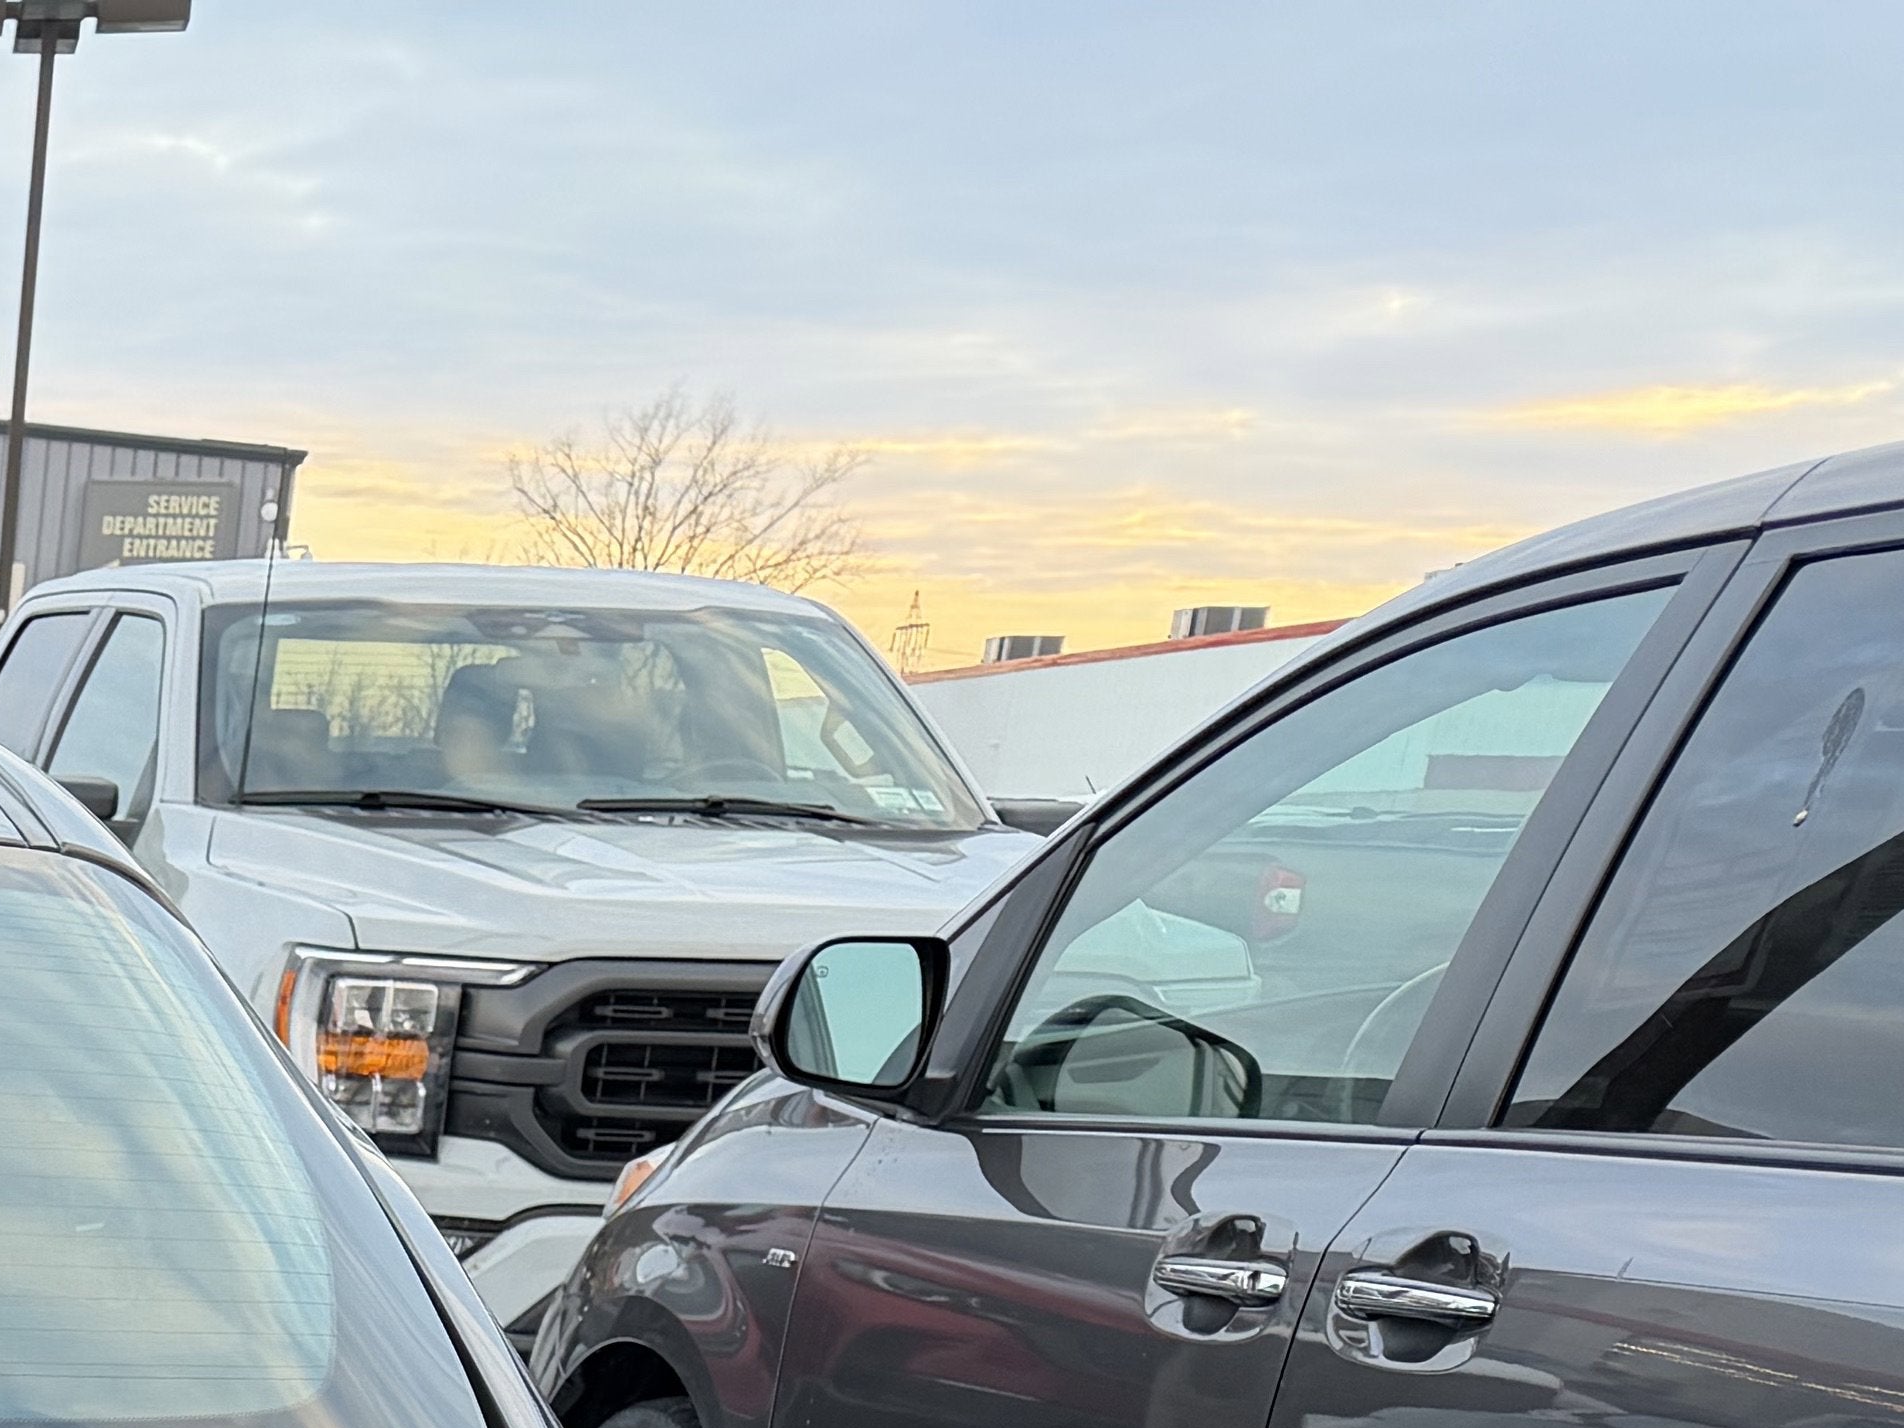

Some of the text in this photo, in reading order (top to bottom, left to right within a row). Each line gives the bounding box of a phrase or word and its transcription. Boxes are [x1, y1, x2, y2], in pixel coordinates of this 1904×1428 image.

[147, 494, 220, 515] SERVICE
[102, 515, 218, 537] DEPARTMENT
[122, 537, 215, 558] ENTRANCE
